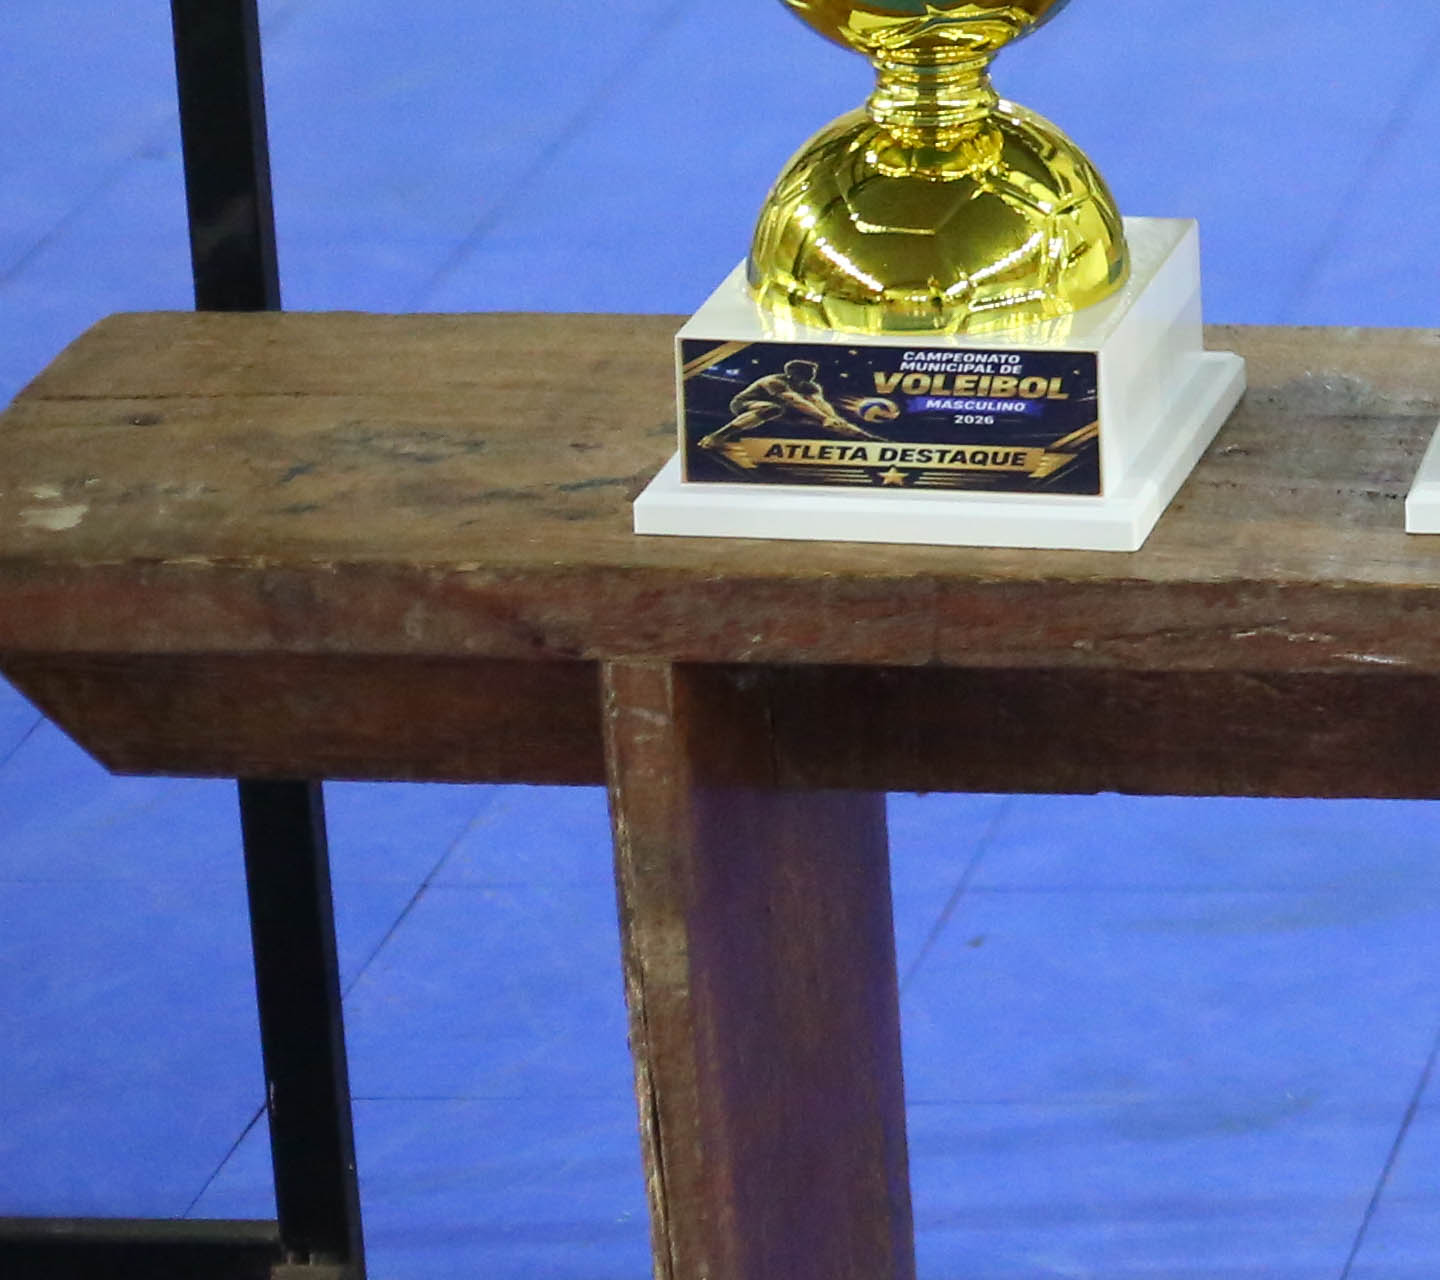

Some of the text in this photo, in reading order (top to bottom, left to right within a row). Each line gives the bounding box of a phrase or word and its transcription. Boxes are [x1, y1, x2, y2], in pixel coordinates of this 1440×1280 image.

[901, 351, 1020, 365] CAMPEONATO
[901, 362, 1022, 375] MUNICIPAL DE
[873, 371, 1069, 399] VOLEIBOL
[926, 399, 1026, 412] MASCULINO
[954, 414, 994, 425] 2026
[764, 443, 1027, 467] ATLETA DESTAQUE
